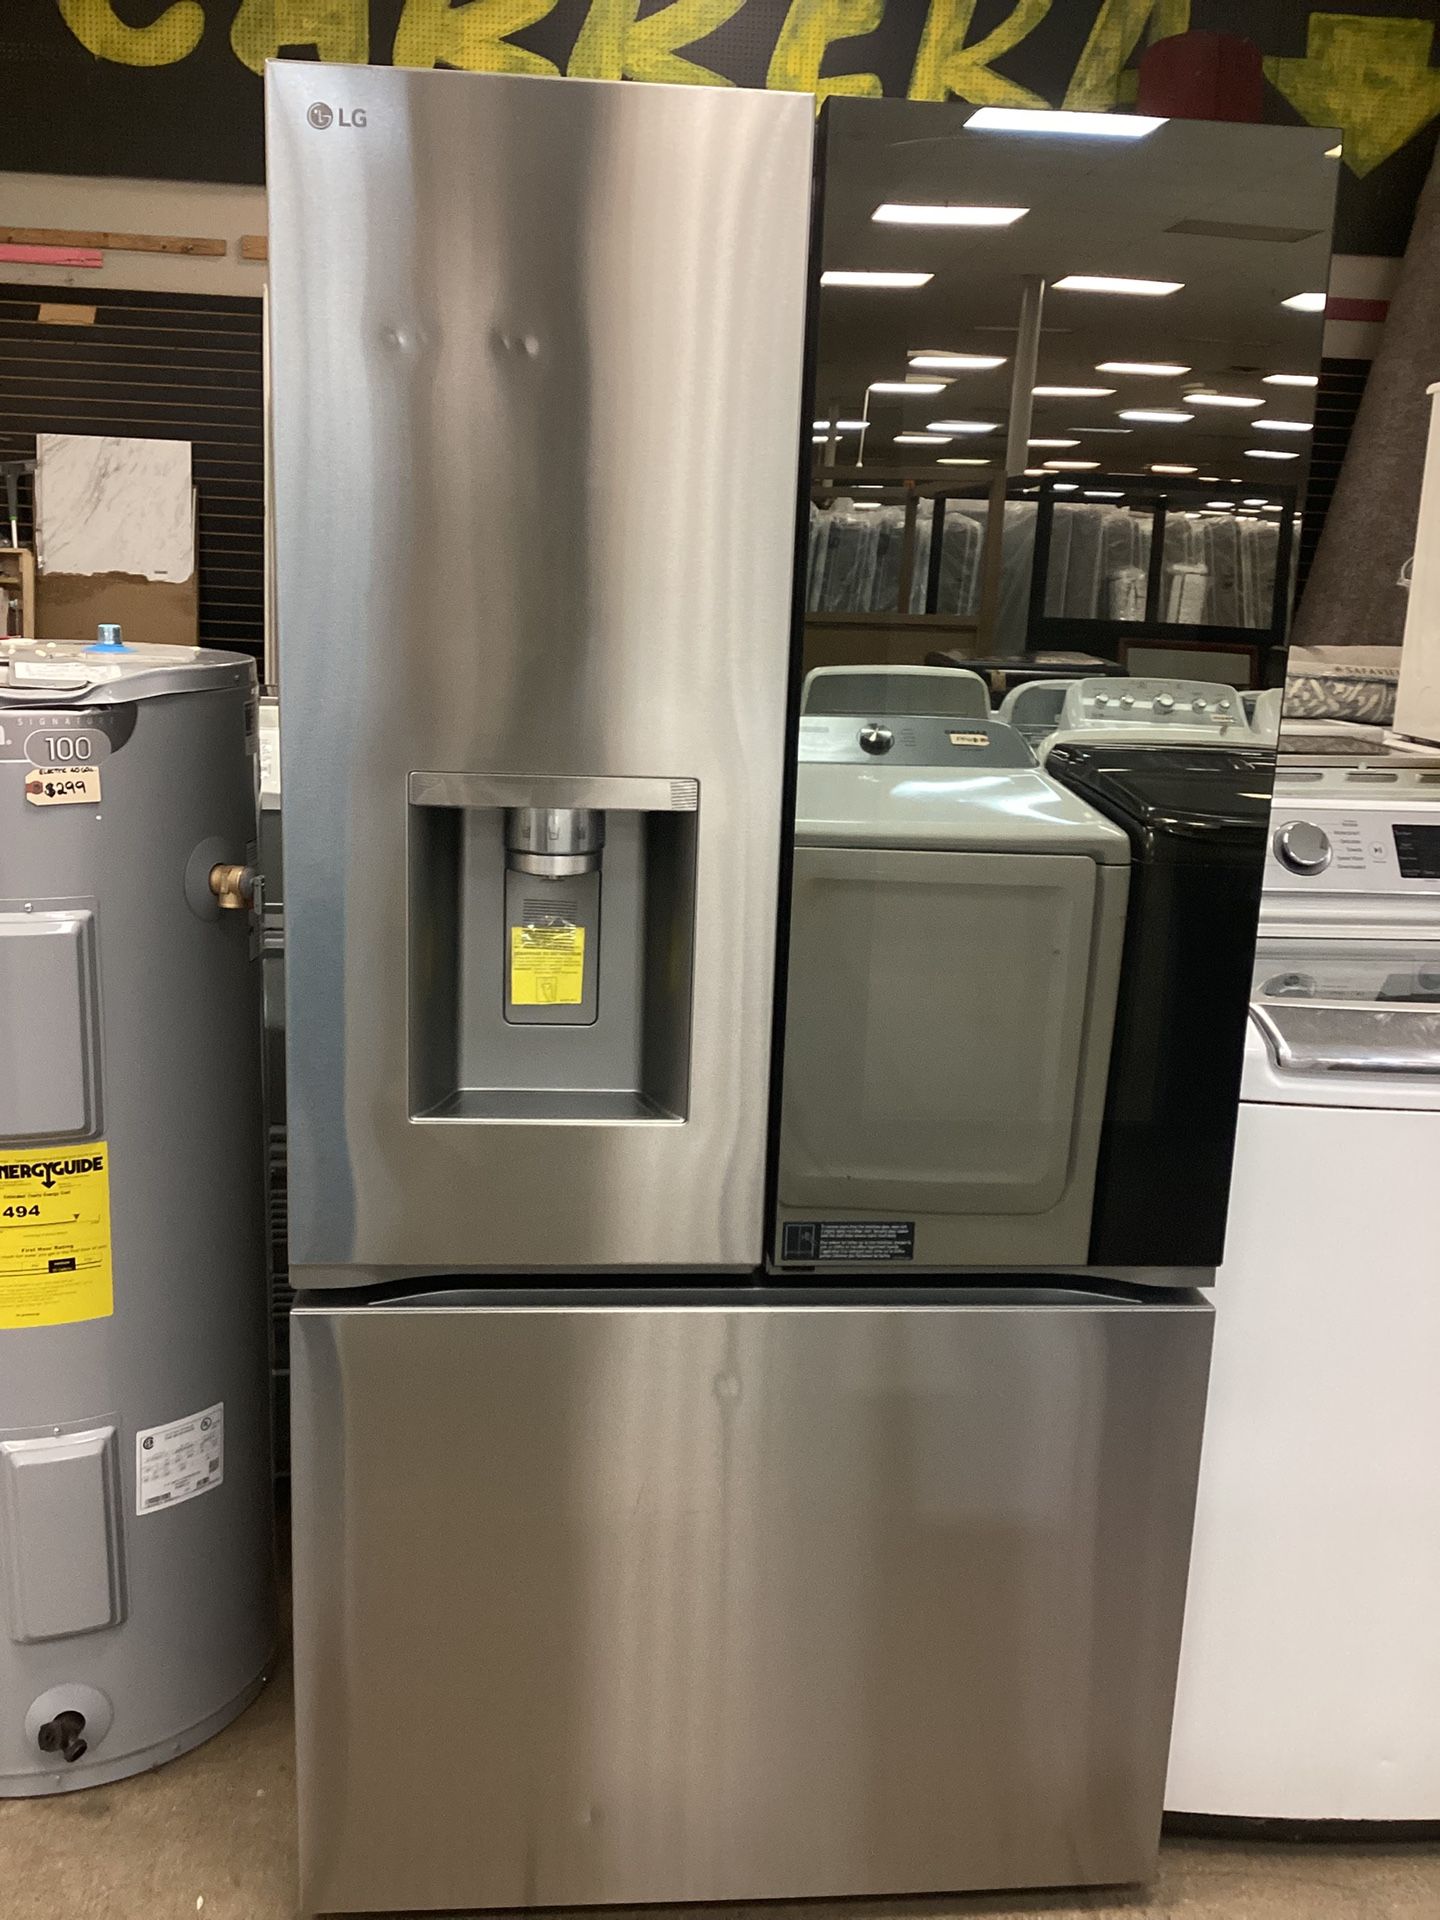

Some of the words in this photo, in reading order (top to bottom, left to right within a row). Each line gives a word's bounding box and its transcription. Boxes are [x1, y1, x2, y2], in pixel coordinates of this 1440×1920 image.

[338, 108, 368, 128] LG
[45, 736, 92, 761] 100
[44, 780, 87, 798] $299
[2, 1204, 41, 1218] 494
